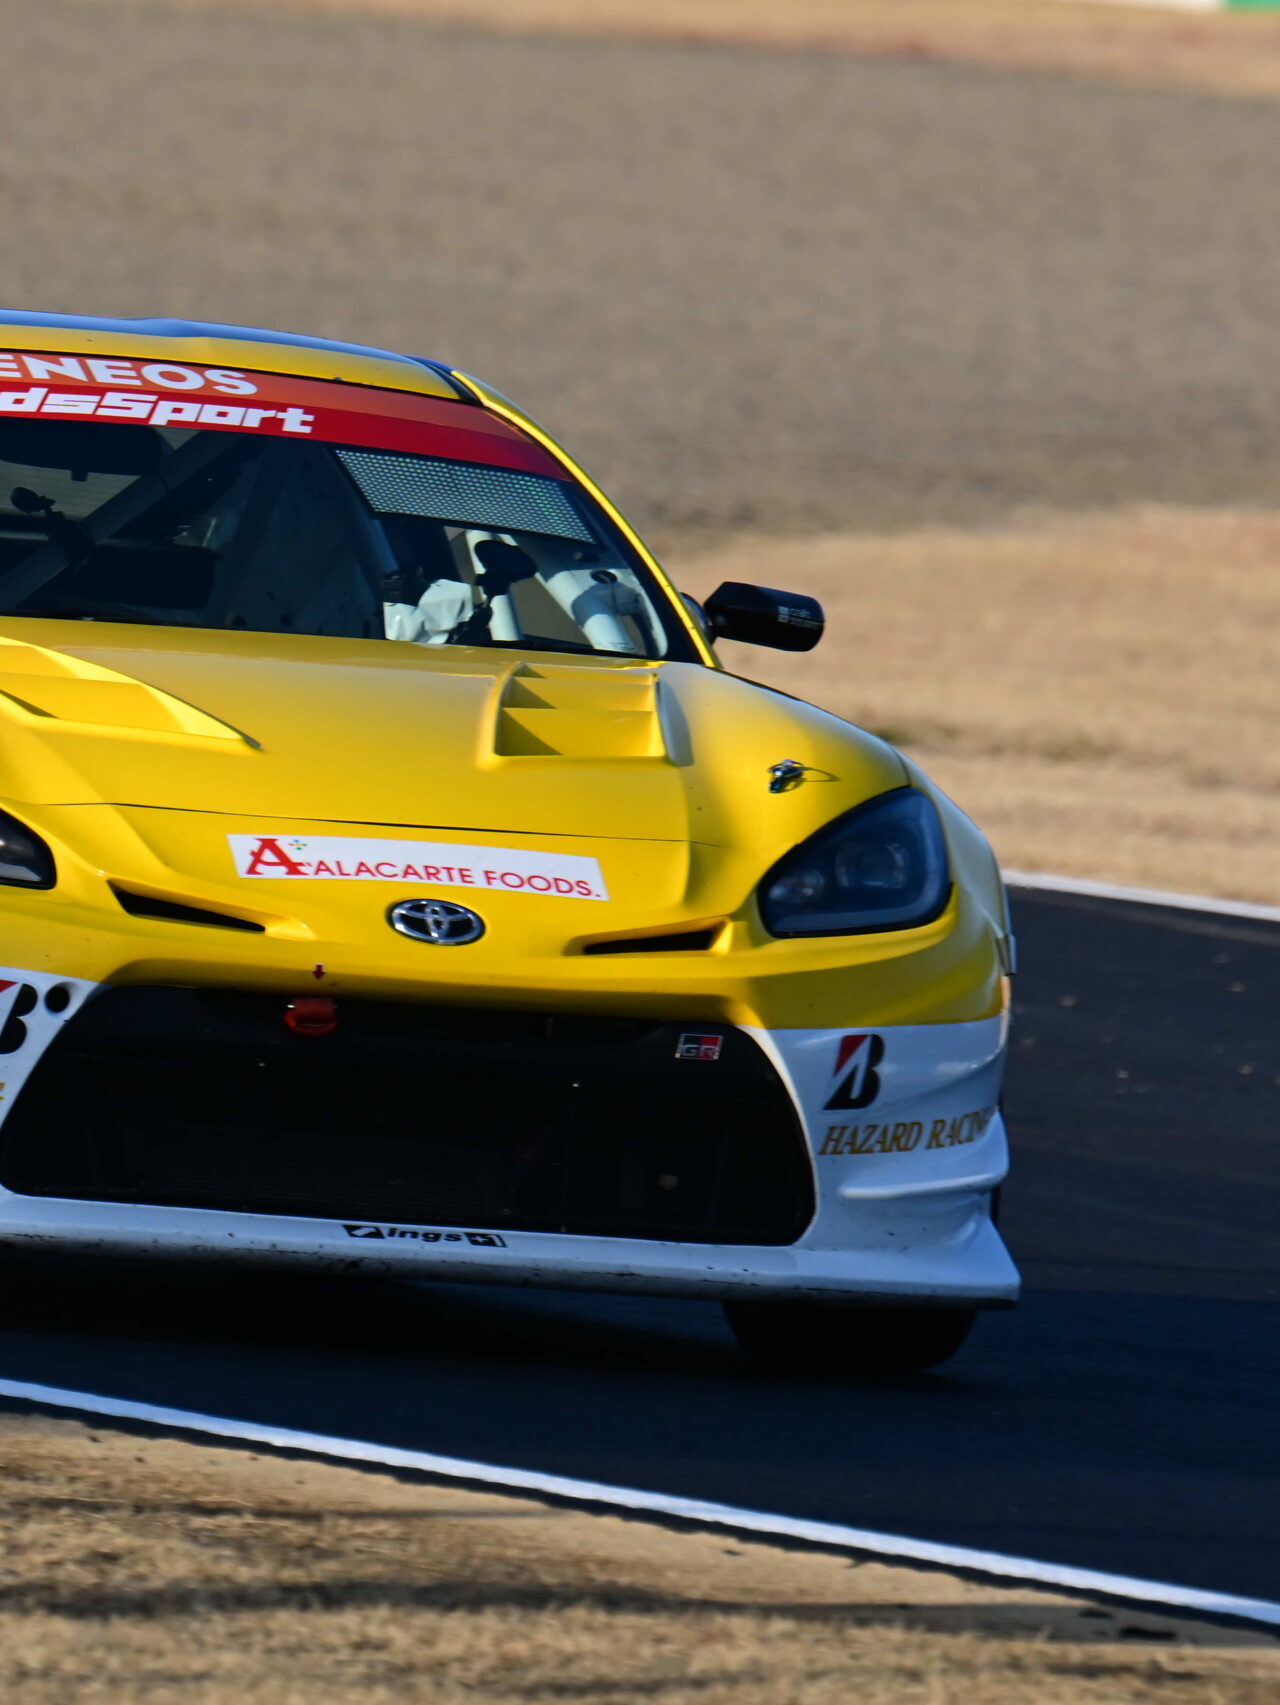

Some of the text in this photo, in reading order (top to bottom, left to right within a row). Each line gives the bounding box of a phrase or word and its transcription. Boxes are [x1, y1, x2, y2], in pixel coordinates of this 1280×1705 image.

[313, 860, 475, 885] ALACARTE
[483, 869, 602, 898] FOODS.
[817, 1121, 924, 1155] HAZARD
